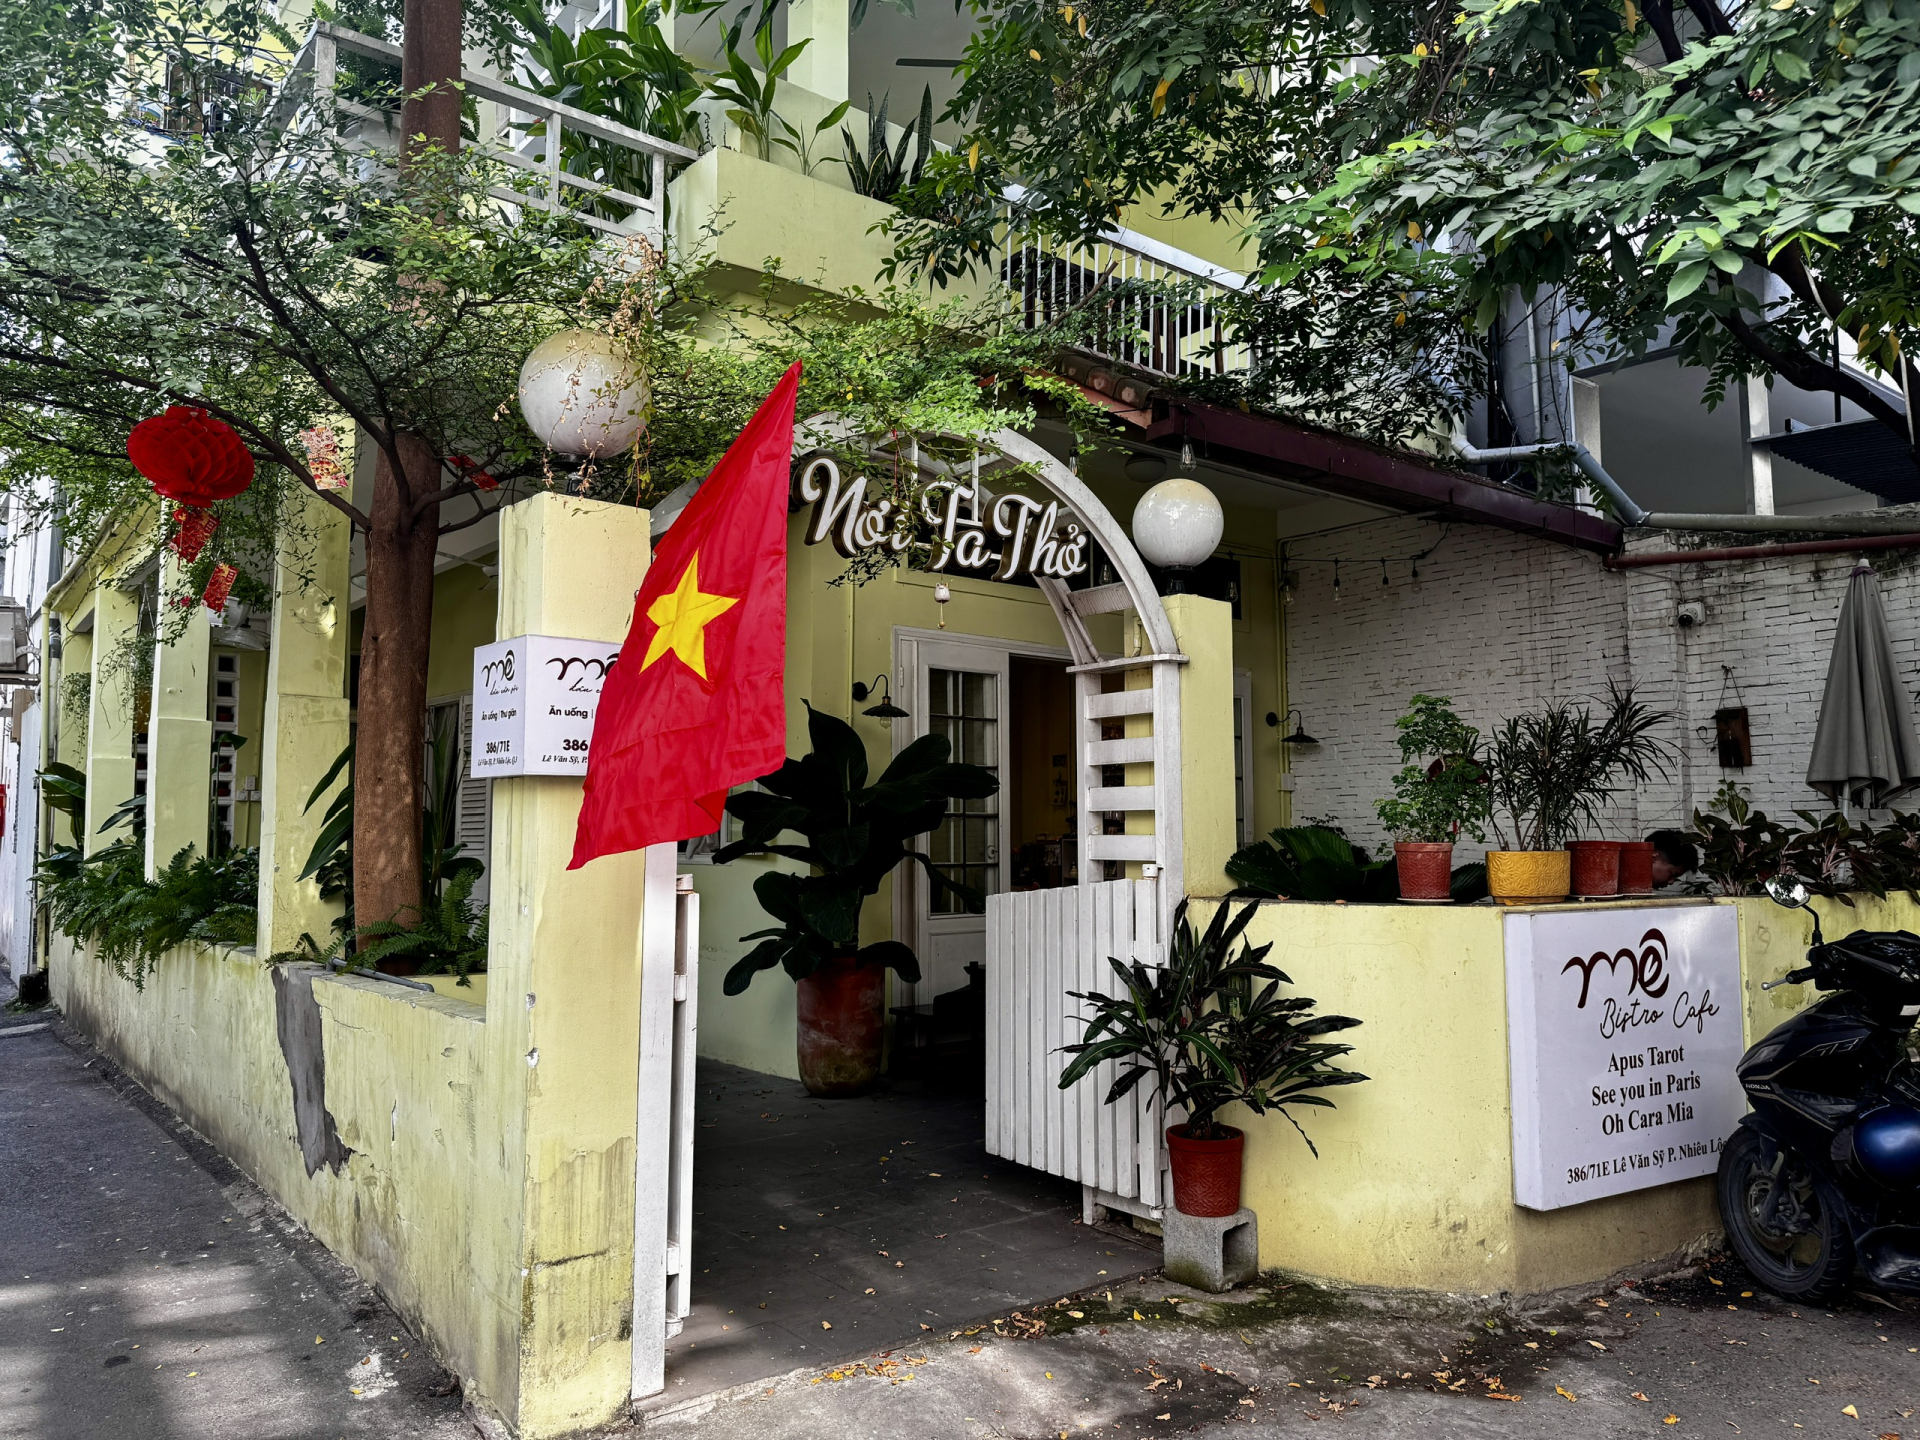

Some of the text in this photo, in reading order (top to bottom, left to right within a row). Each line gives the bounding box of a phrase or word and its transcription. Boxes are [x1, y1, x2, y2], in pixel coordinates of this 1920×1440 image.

[920, 480, 993, 571] Ta
[991, 493, 1089, 581] Thở
[548, 705, 589, 719] Ăn uống
[486, 739, 510, 754] 386/71E
[541, 754, 552, 763] Lê
[553, 754, 568, 763] Văn
[568, 756, 580, 765] Sỹ,
[1560, 927, 1670, 1009] mê
[1600, 989, 1720, 1039] Bistro Cafe
[1607, 1044, 1685, 1077] Apus Tarot
[1591, 1070, 1701, 1108] See you in Paris
[1602, 1101, 1694, 1136] Oh Cara Mia
[1566, 1160, 1611, 1184] 386/71E
[1612, 1156, 1627, 1175] Lê
[1628, 1153, 1651, 1171] Văn
[1652, 1149, 1666, 1169] Sỹ
[1667, 1146, 1678, 1163] P.
[1678, 1140, 1709, 1161] Nhiêu
